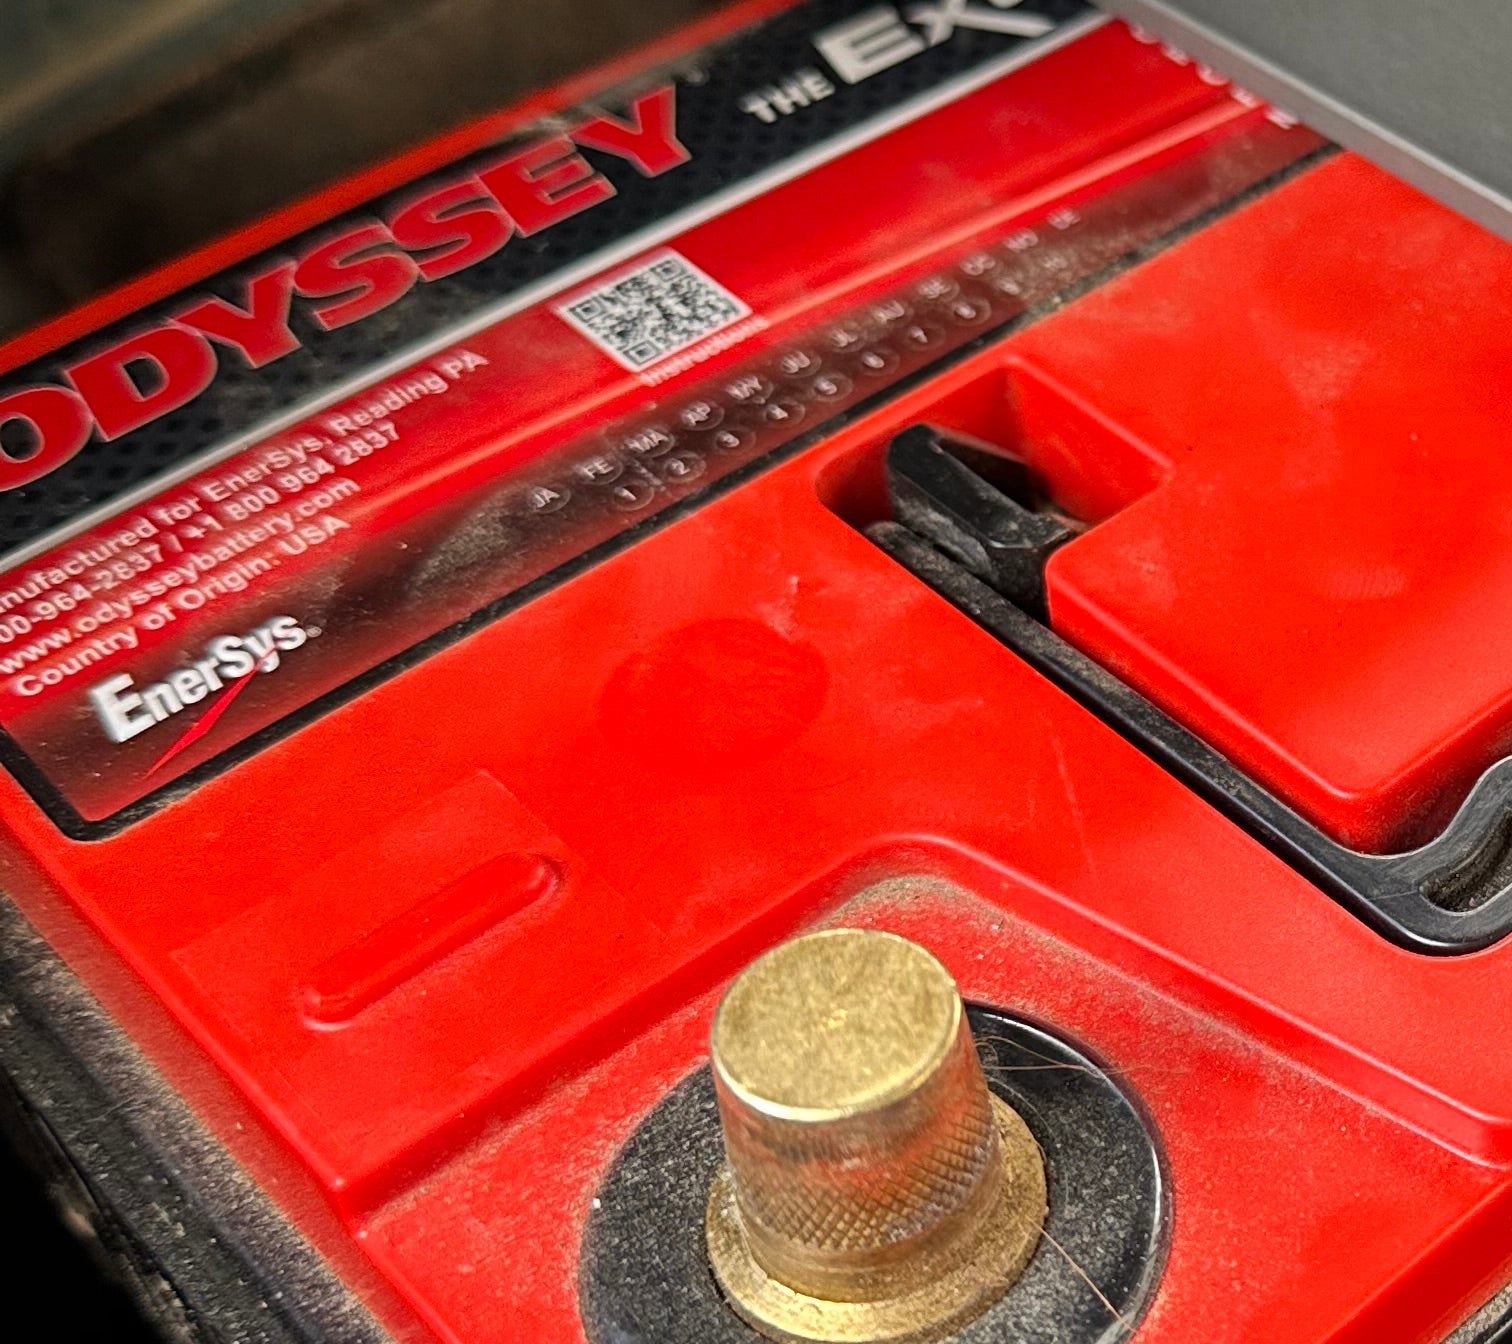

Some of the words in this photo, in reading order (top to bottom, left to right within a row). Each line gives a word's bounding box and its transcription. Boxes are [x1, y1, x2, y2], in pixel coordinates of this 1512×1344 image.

[0, 83, 691, 492] ODYSSEY
[738, 64, 835, 124] THE
[0, 516, 160, 613] nufactured
[152, 496, 203, 526] for
[327, 370, 449, 437] Reading
[439, 349, 489, 380] PA
[226, 484, 282, 522] 800
[276, 456, 336, 494] 964
[331, 419, 400, 467] 2837
[526, 486, 561, 508] JA
[576, 458, 615, 481] FE
[625, 428, 669, 454] MA
[681, 401, 711, 426] AP
[0, 477, 361, 676] www.odysseybattery.com
[13, 625, 139, 698] Country
[141, 599, 177, 631] of
[276, 514, 351, 557] USA
[88, 615, 308, 744] EnerSys
